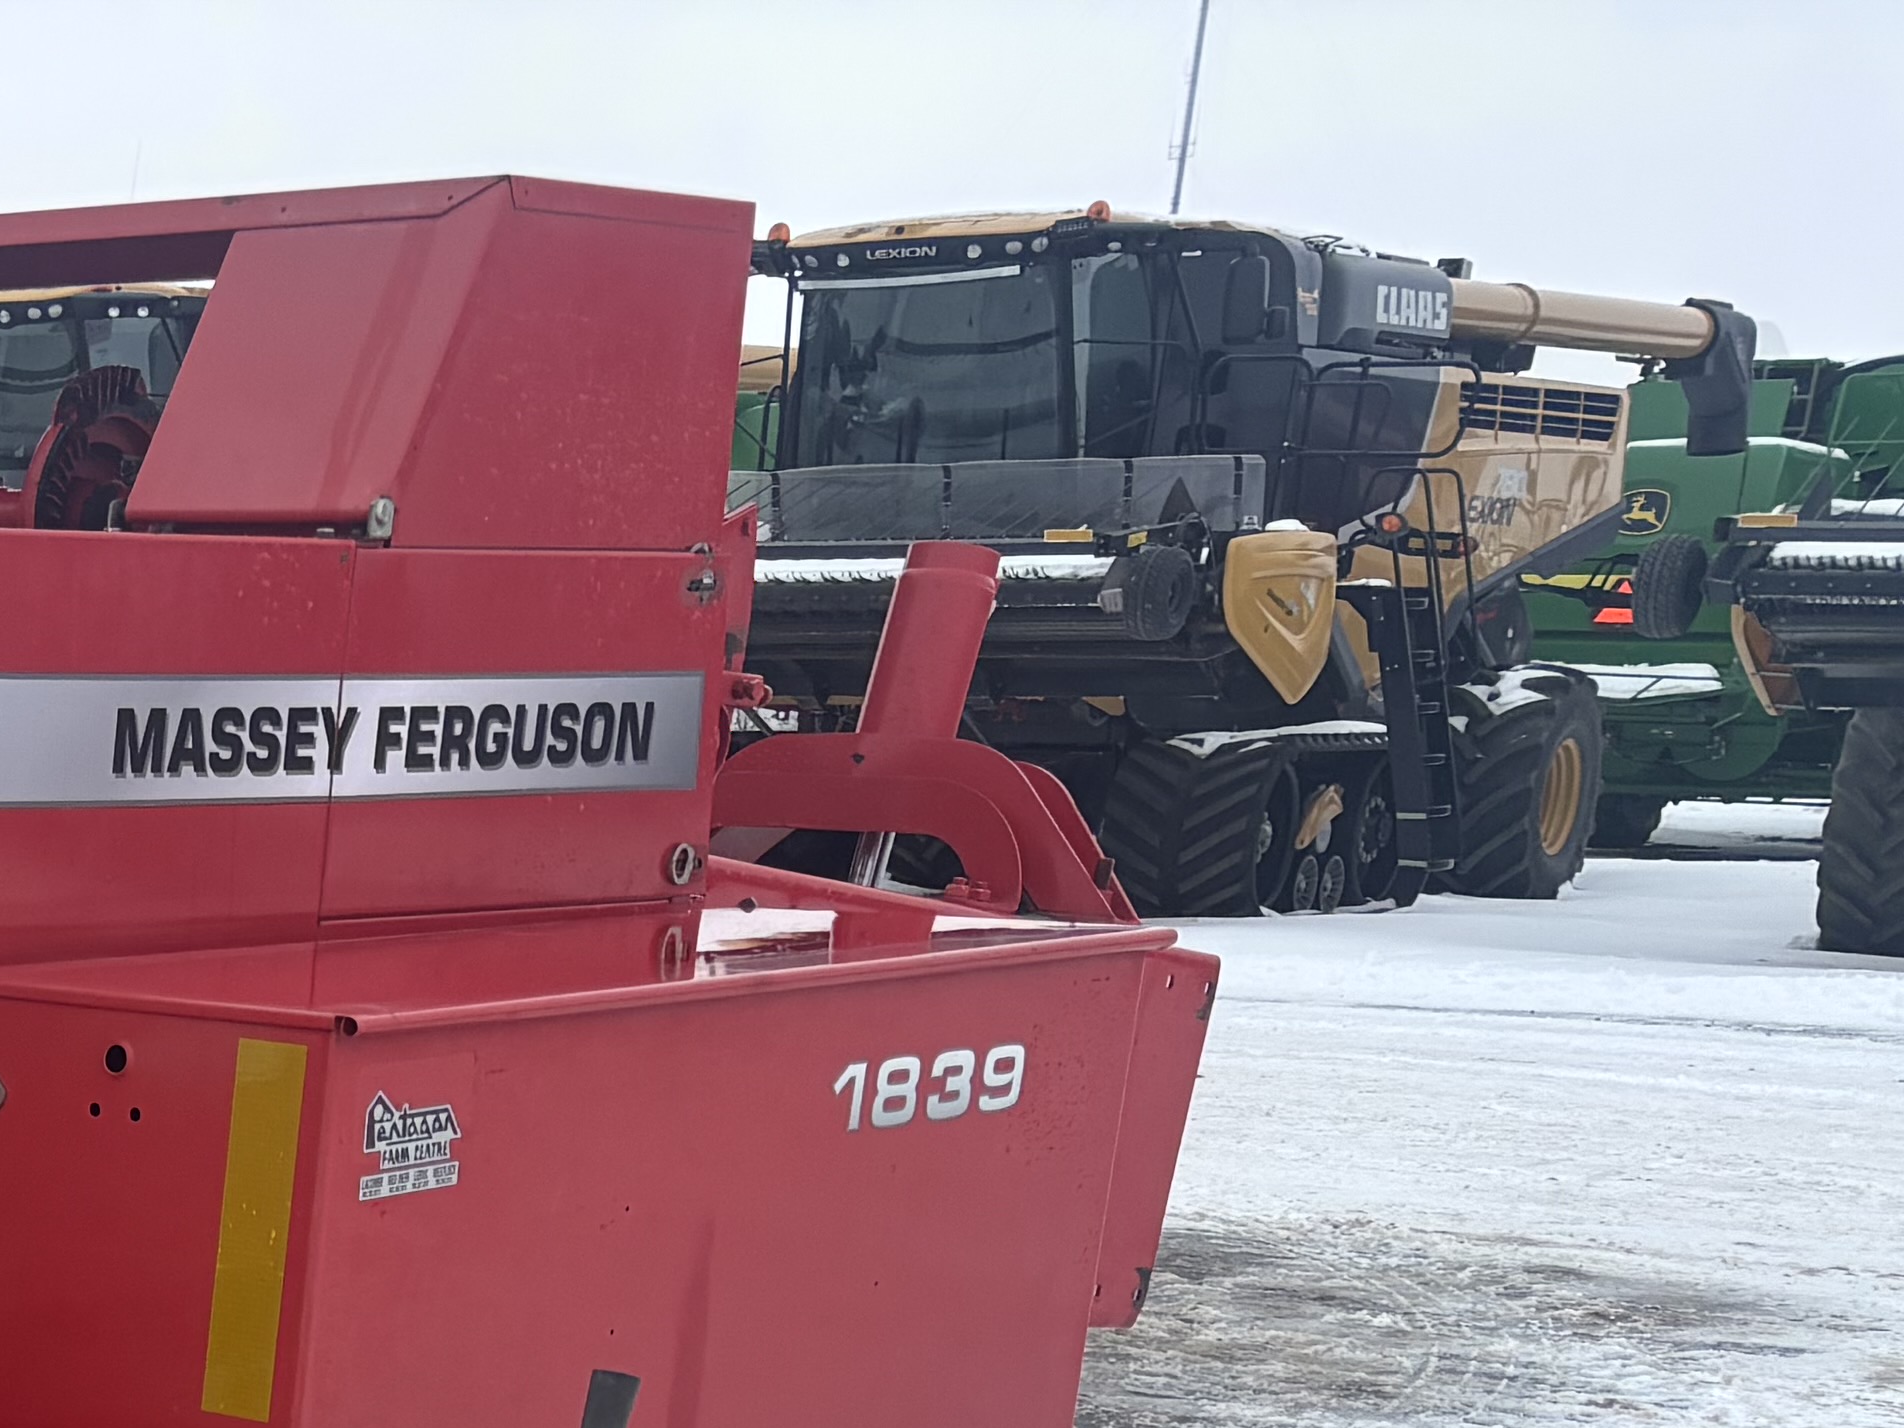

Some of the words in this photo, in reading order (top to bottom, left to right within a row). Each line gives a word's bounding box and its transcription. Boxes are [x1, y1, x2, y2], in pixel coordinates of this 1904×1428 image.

[866, 246, 937, 260] LEXION
[1376, 285, 1449, 330] CLAAS
[112, 704, 360, 779] MASSEY
[373, 700, 656, 774] FERGUSON
[833, 1044, 1025, 1131] 1839
